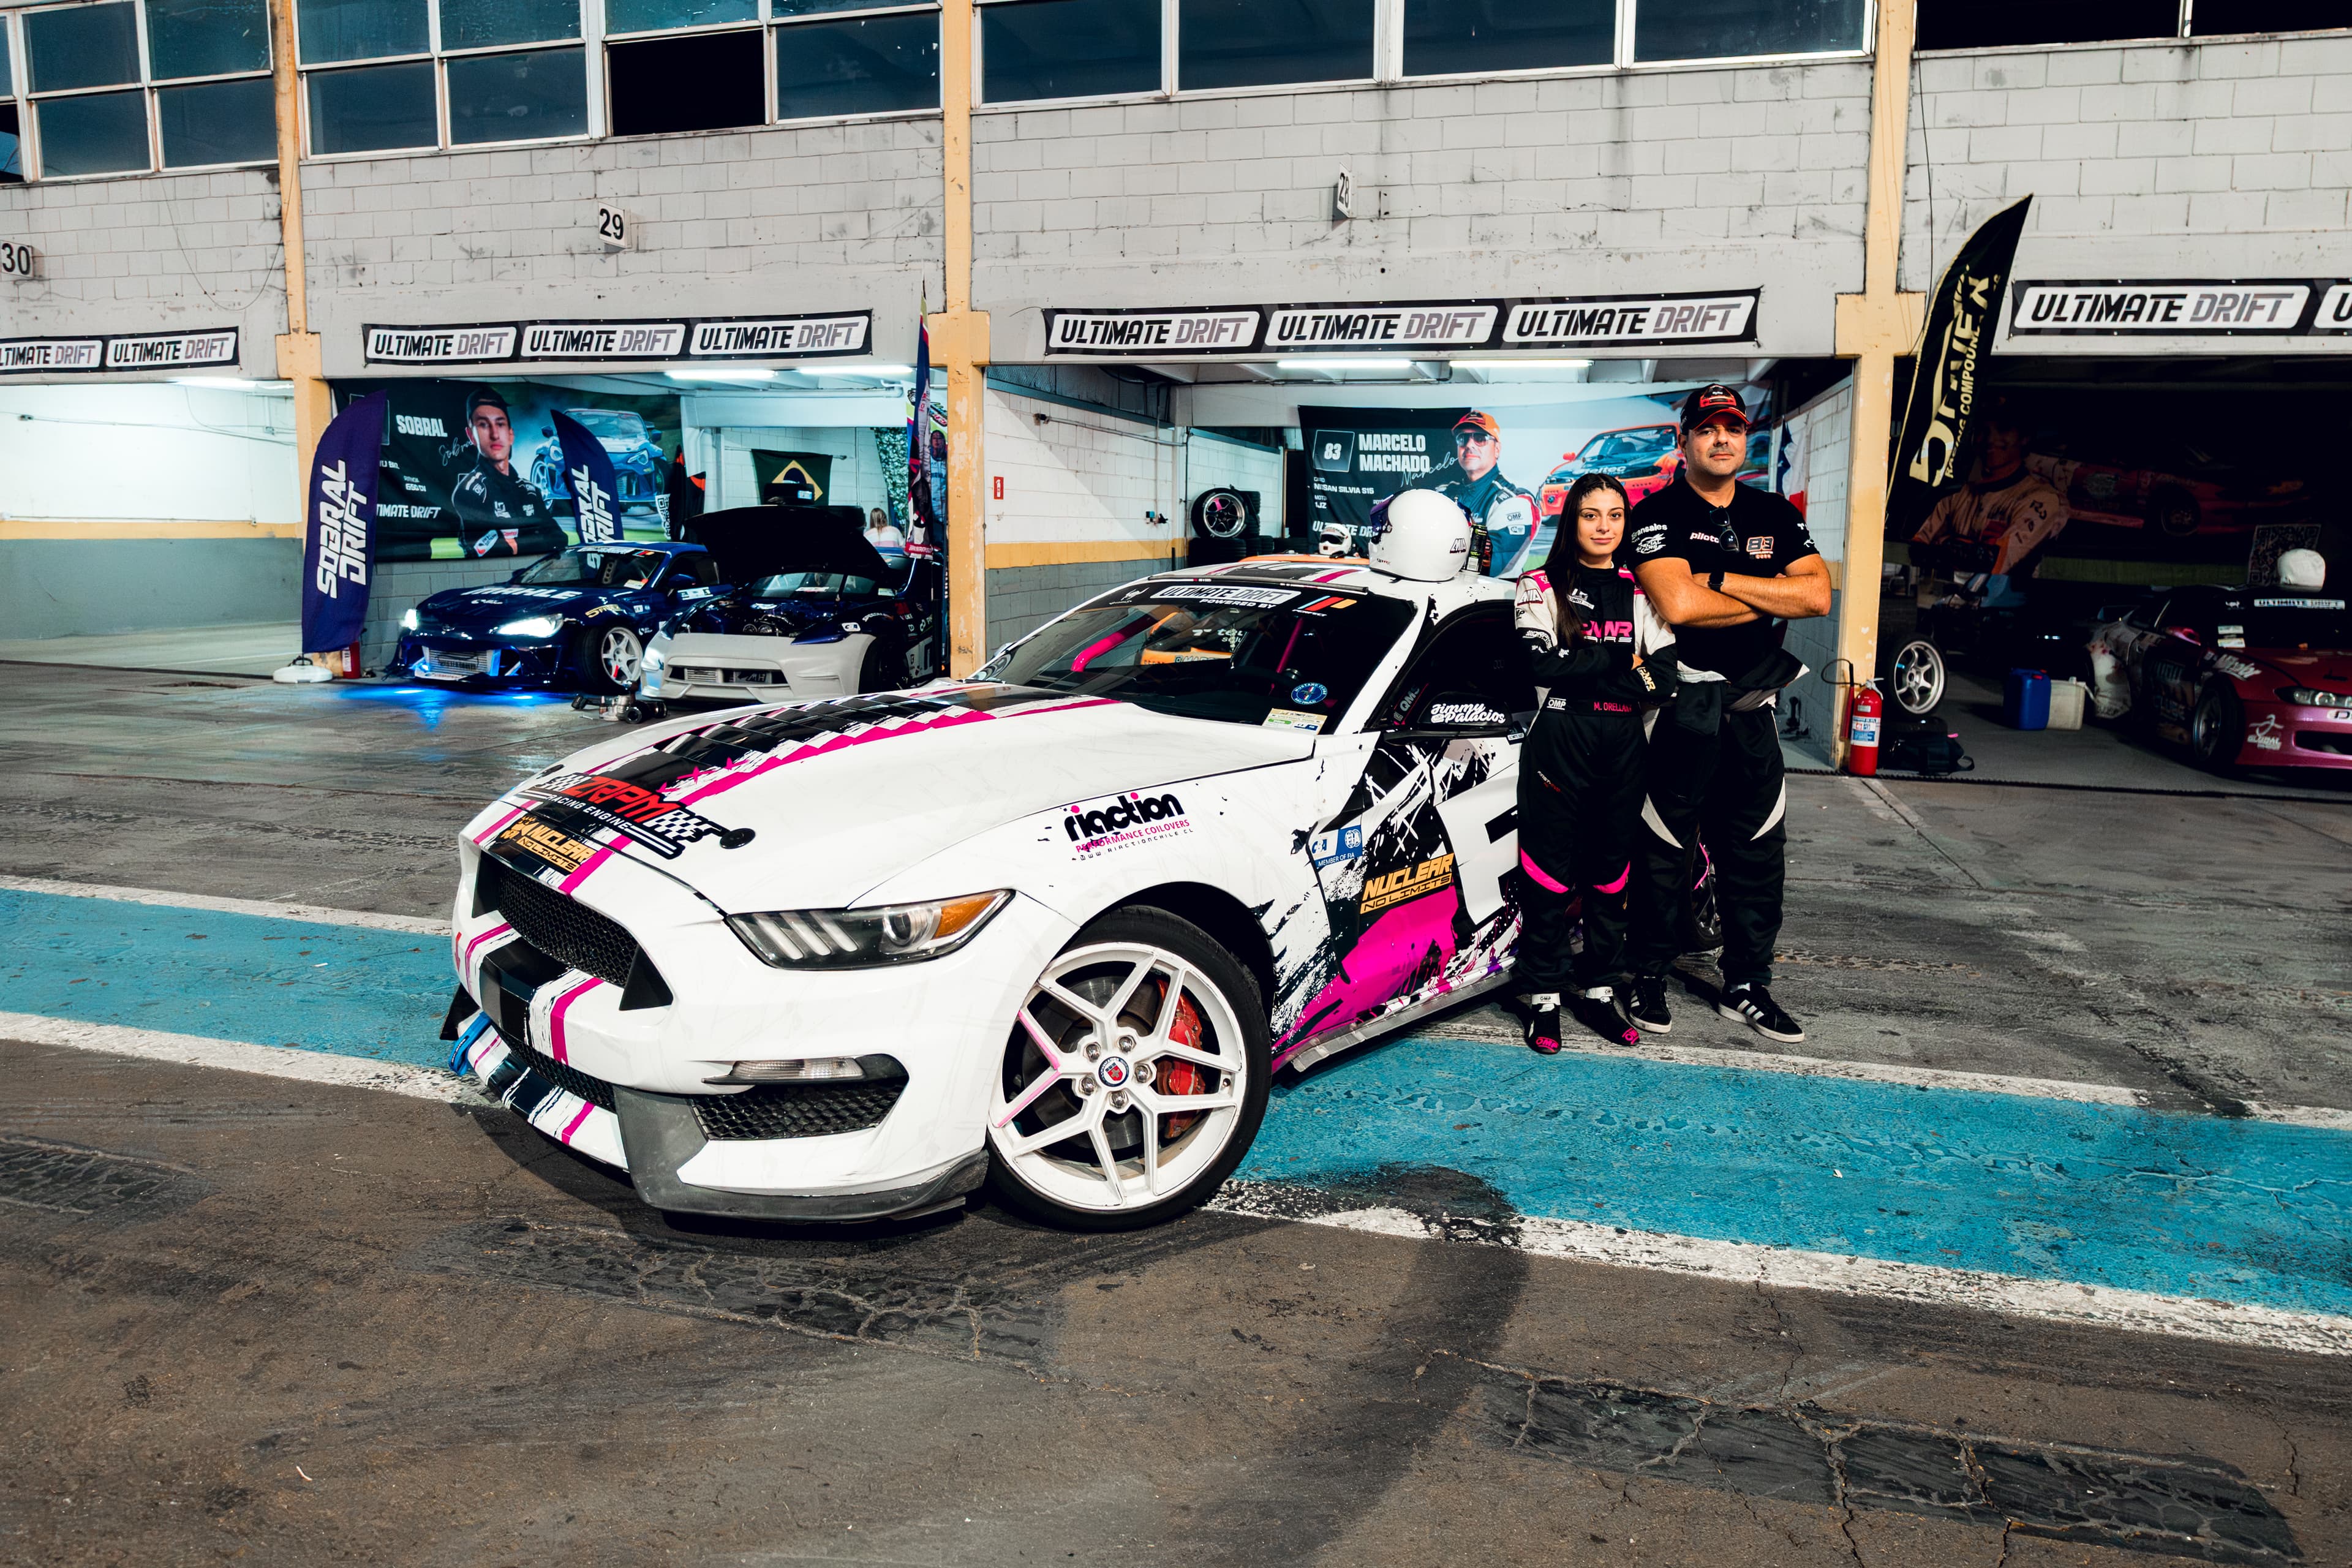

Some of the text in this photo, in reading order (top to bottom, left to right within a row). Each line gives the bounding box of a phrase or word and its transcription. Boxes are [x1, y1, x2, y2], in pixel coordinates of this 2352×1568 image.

[1339, 173, 1350, 208] 28
[599, 209, 625, 240] 29
[1, 243, 31, 275] 30
[1517, 303, 1742, 336] ULTIMATE DRIFT
[2031, 293, 2295, 323] ULTIMATE DRIFT
[699, 322, 859, 350] ULTIMATE DRIFT
[1061, 317, 1250, 345] ULTIMATE DRIFT
[1278, 312, 1486, 341] ULTIMATE DRIFT
[114, 337, 229, 362] ULTIMATE DRIFT
[375, 332, 509, 356] ULTIMATE DRIFT
[530, 329, 677, 352] ULTIMATE DRIFT
[0, 345, 96, 366] LTIMATE DRIFT
[396, 415, 448, 437] SOBRAL
[1324, 442, 1342, 460] 83
[1359, 434, 1426, 452] MARCELO
[1359, 454, 1430, 472] MACHADO
[376, 503, 441, 519] TIMATE DRIFT
[317, 459, 346, 599] SOBRAL
[339, 480, 368, 586] DRIFT
[1746, 536, 1774, 552] 83
[461, 587, 582, 600] MAHLE
[1159, 586, 1292, 603] ULTIMATE DRIFT
[1200, 598, 1256, 608] POWERED
[1431, 703, 1485, 715] Jimmy
[1548, 698, 1567, 708] OMP
[1594, 702, 1602, 710] M.
[1446, 709, 1506, 723] Palacios
[545, 794, 586, 810] RACING
[1065, 792, 1185, 842] riaction
[526, 822, 599, 862] NUCLEAR
[1076, 819, 1190, 853] PERFORMANCE COILOVERS
[521, 838, 578, 871] NO LIMITS
[1318, 856, 1340, 867] MEMBER
[1362, 852, 1455, 902] NUCLEAR
[1363, 875, 1452, 911] NO LIMITS
[1536, 1037, 1559, 1049] OMP
